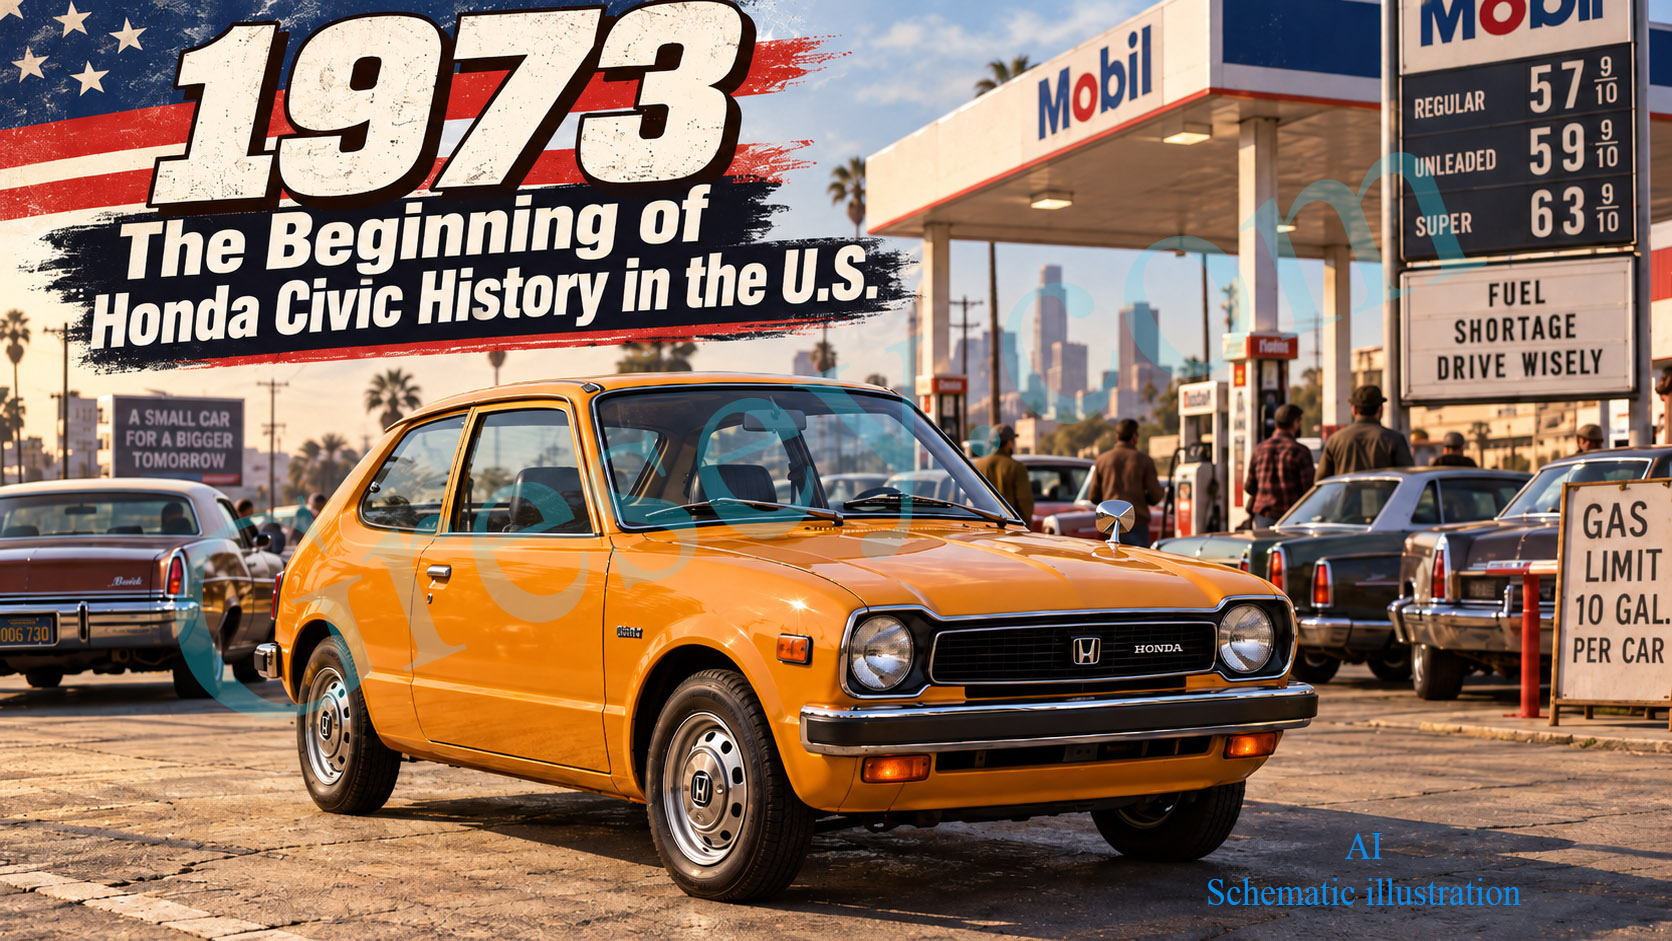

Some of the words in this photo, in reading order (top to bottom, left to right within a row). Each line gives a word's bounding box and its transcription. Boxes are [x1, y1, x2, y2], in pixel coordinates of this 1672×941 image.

[1420, 0, 1604, 47] Mob
[1038, 24, 1152, 141] Mobil
[1414, 90, 1486, 120] REGULAR
[1529, 59, 1585, 114] 57
[1414, 149, 1497, 178] UNLEADED
[1529, 122, 1585, 176] 59
[1415, 212, 1473, 237] SUPER
[1530, 186, 1585, 238] 63
[1488, 279, 1546, 308] FUEL
[1454, 313, 1577, 344] SHORTAGE
[1437, 354, 1506, 381] DRIVE
[1522, 349, 1604, 378] WISELY
[128, 408, 140, 426] A
[145, 408, 196, 427] SMALL
[199, 410, 231, 428] CAR
[125, 430, 158, 447] FOR
[161, 431, 173, 448] A
[176, 431, 234, 449] BIGGER
[132, 451, 227, 469] TOMORROW
[1582, 500, 1648, 540] GAS
[1585, 548, 1663, 583] LIMIT
[1575, 594, 1602, 626] 10
[1615, 593, 1672, 626] GAL.
[0, 626, 24, 643] 006
[26, 625, 49, 642] 730
[1134, 643, 1184, 654] HONDA
[1573, 637, 1612, 664] PER
[1622, 637, 1665, 664] CAR
